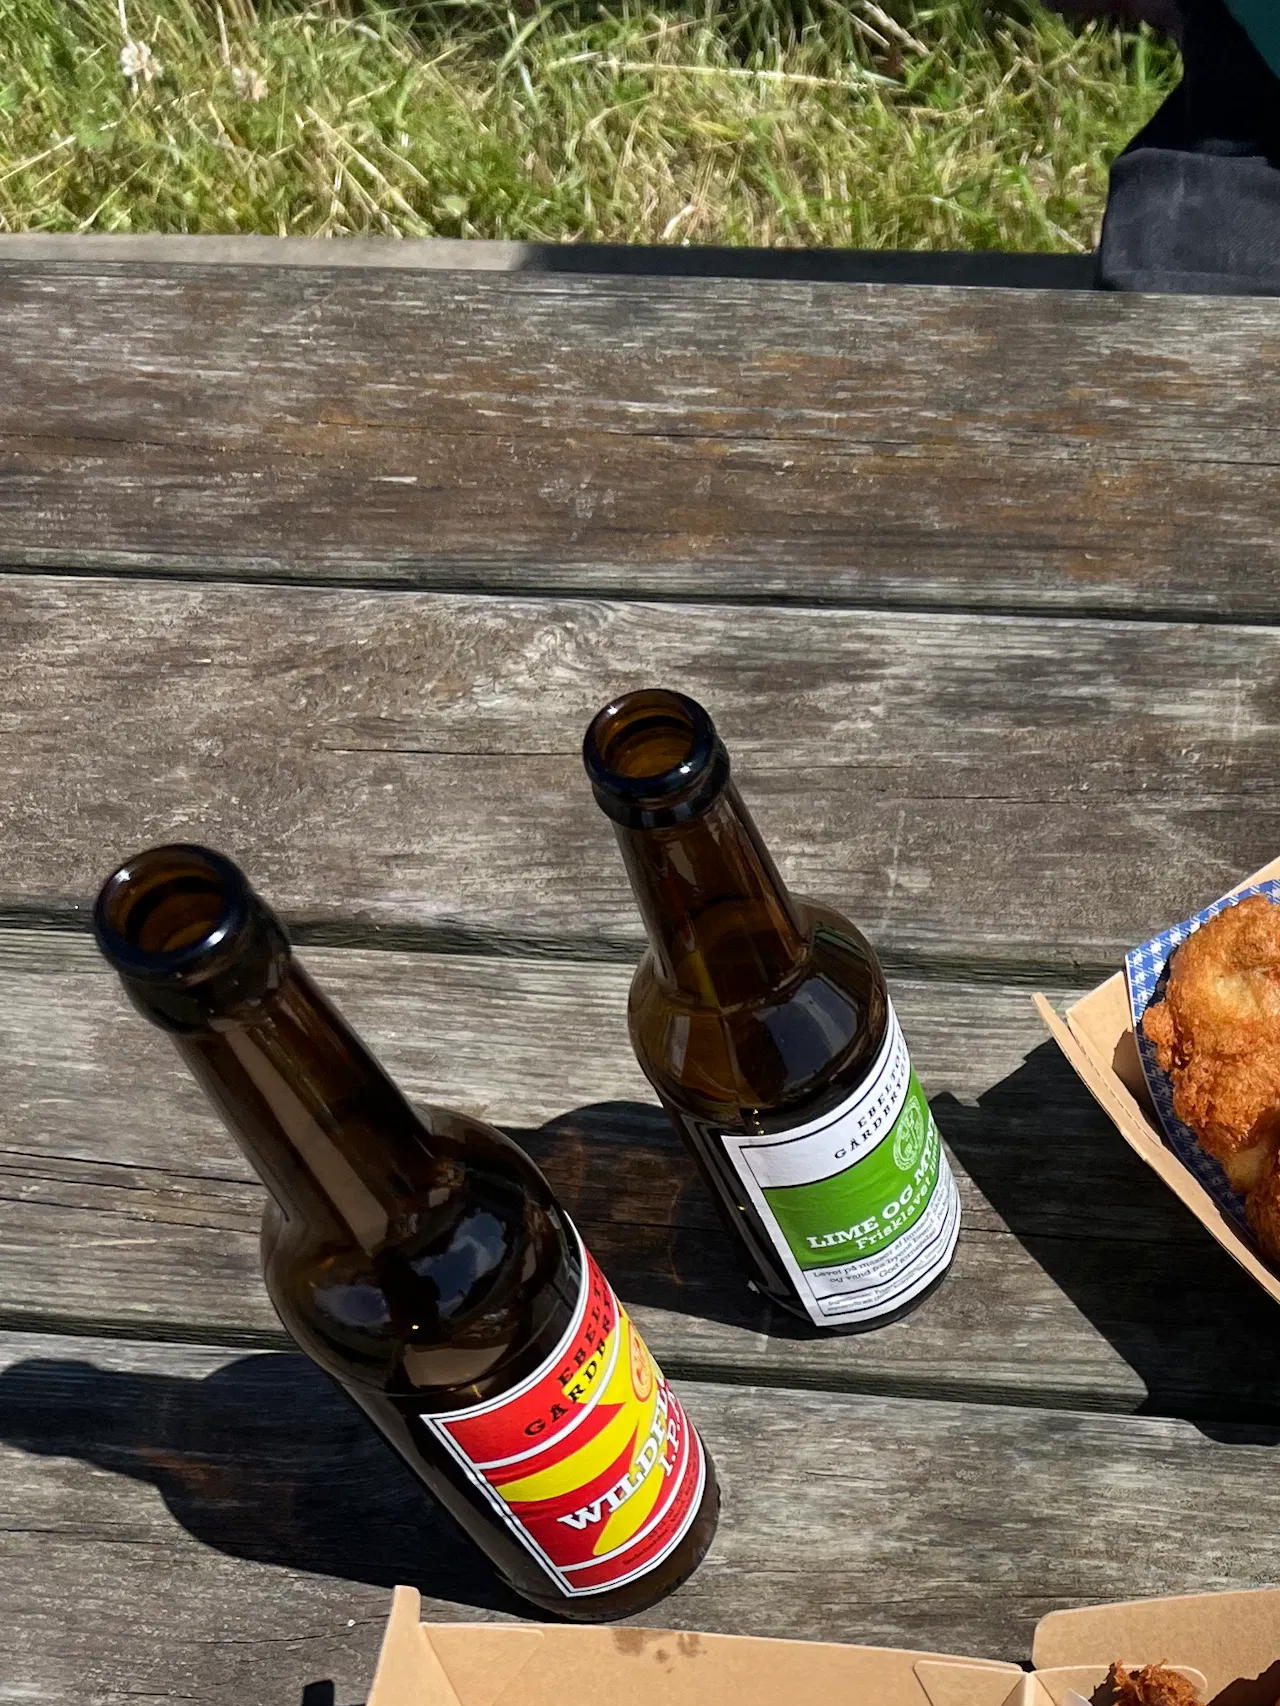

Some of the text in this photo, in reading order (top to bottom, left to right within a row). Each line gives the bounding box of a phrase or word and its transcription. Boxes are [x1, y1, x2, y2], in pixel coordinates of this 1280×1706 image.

[806, 1216, 879, 1249] LIME
[882, 1184, 913, 1219] OG
[854, 1176, 930, 1250] Frisklavet
